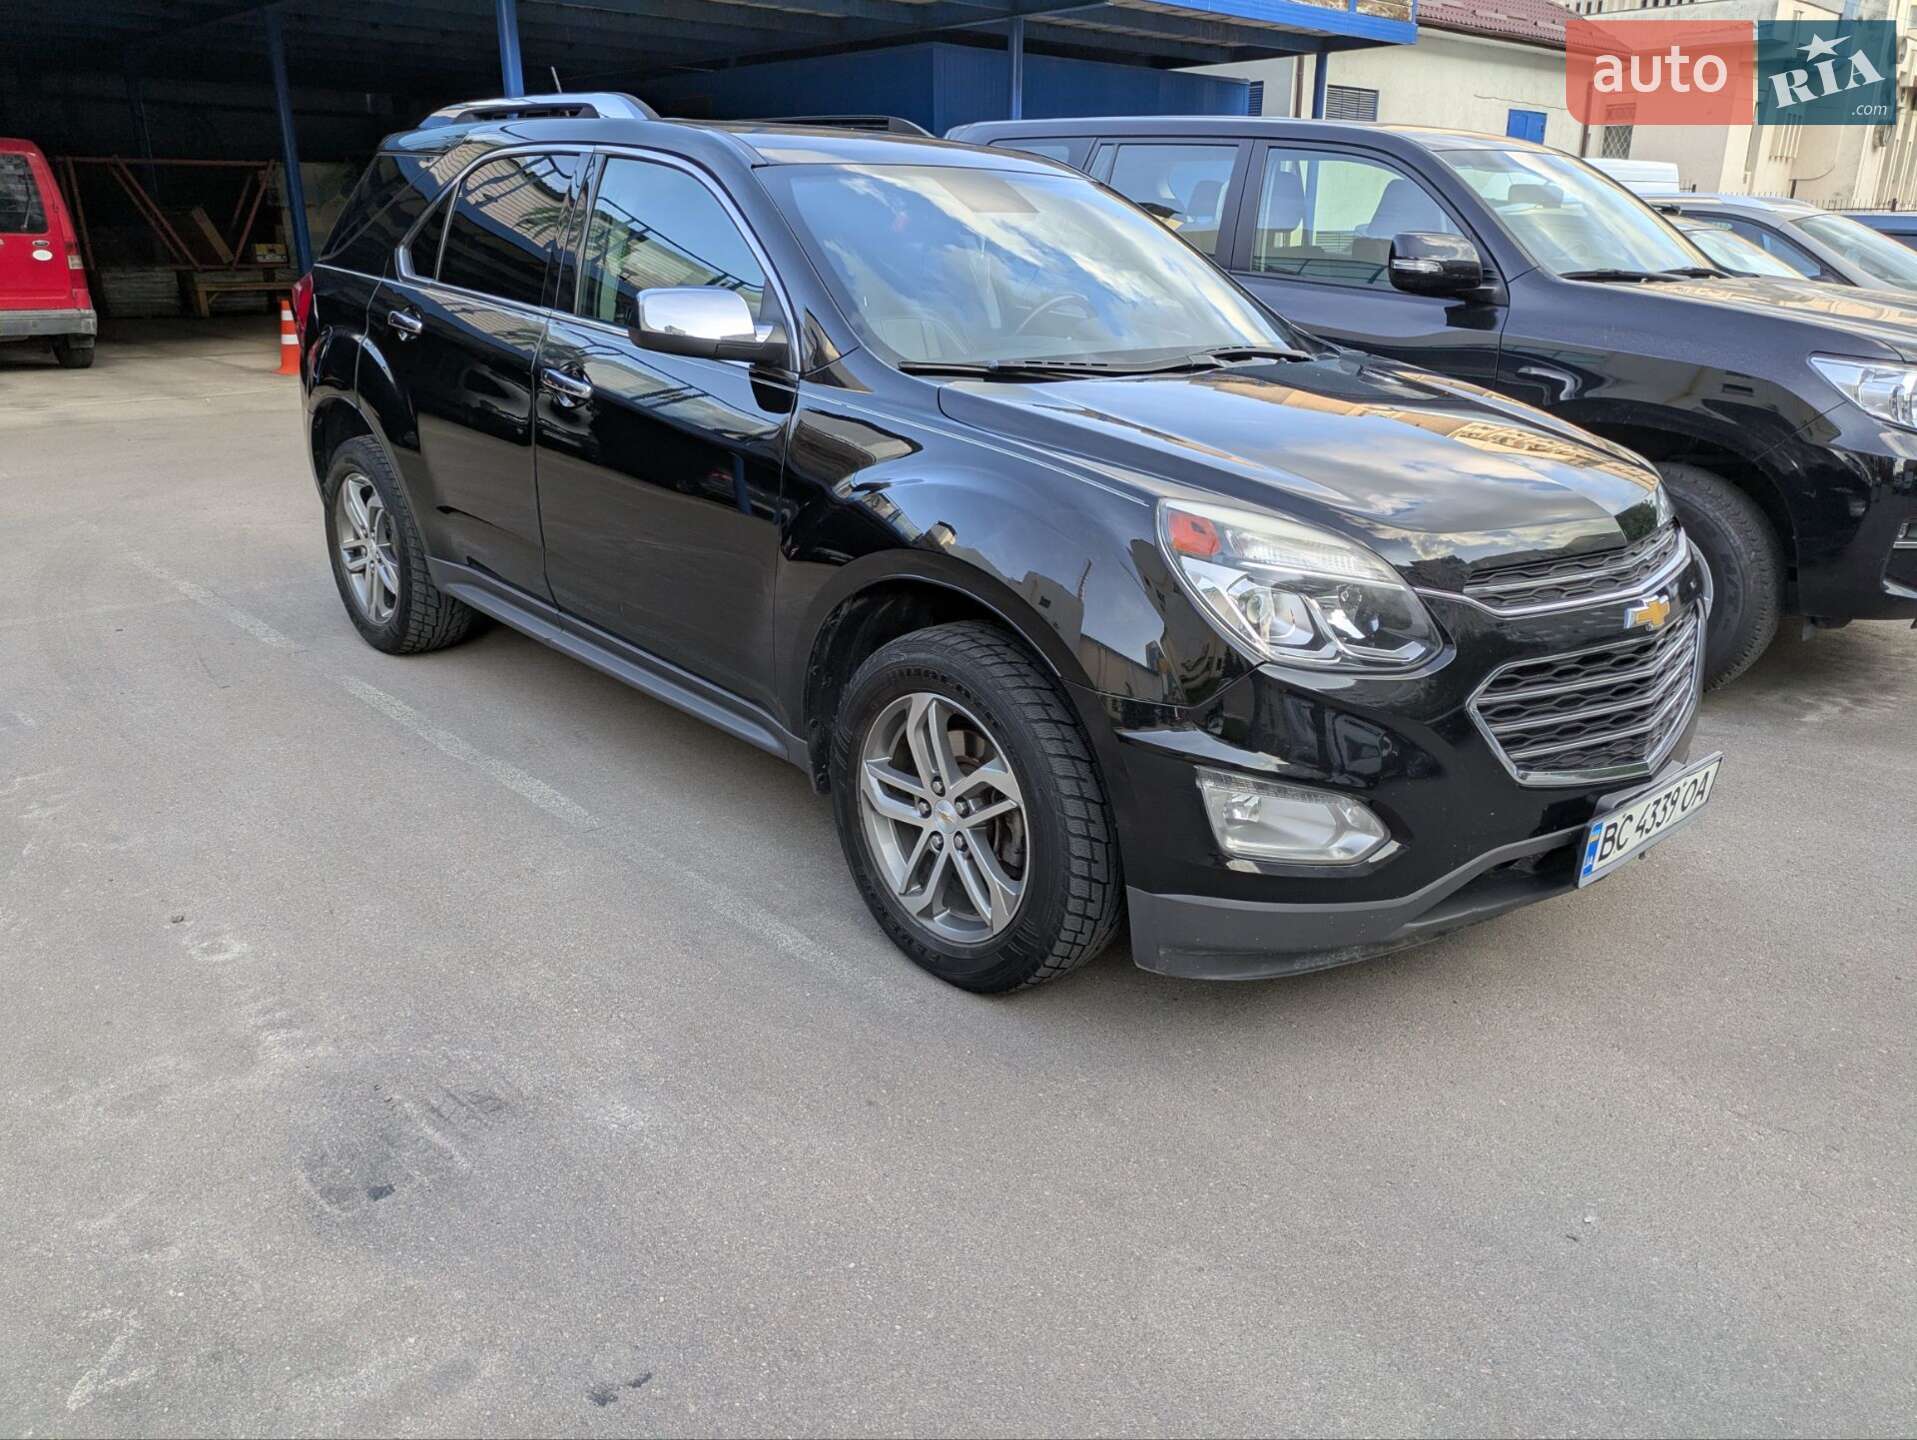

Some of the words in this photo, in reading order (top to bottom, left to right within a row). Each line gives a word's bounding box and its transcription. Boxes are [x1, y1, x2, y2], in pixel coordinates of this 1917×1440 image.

[1598, 814, 1633, 862] BC
[1635, 786, 1681, 838] 4339
[1681, 771, 1710, 812] OA
